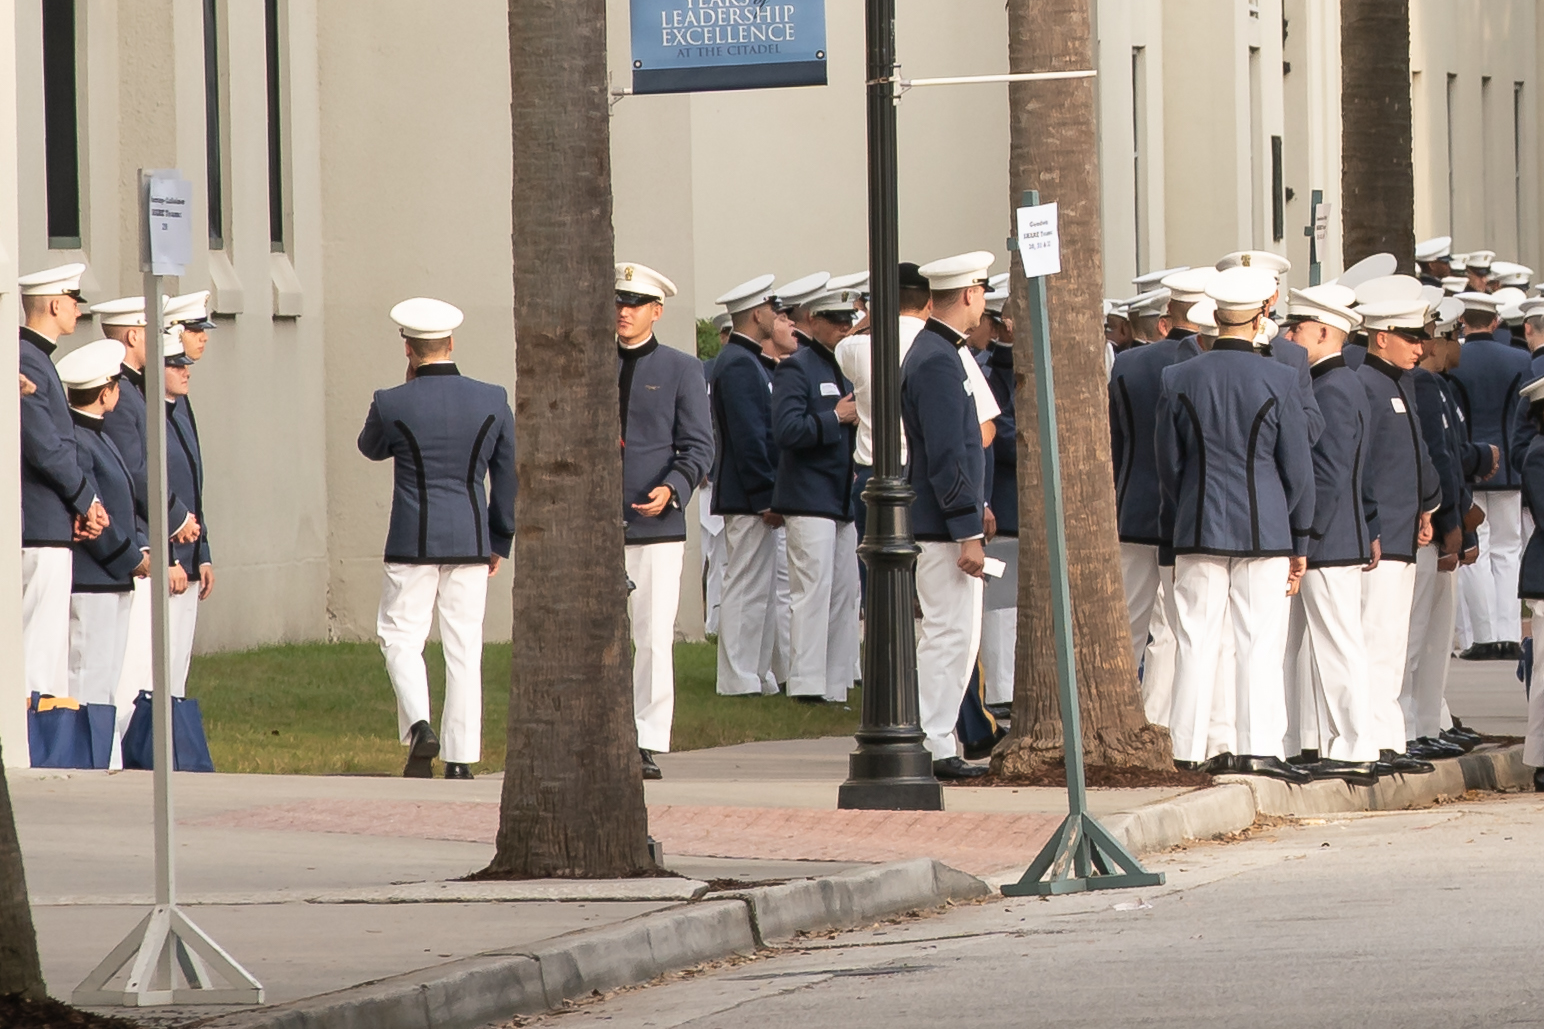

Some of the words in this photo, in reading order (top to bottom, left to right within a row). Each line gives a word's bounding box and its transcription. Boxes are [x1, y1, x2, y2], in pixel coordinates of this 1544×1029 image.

[661, 5, 795, 28] LEADERSHIP
[662, 23, 795, 46] EXCELLENCE
[676, 47, 691, 58] AT
[695, 46, 723, 58] THE
[727, 43, 781, 56] CITADEL
